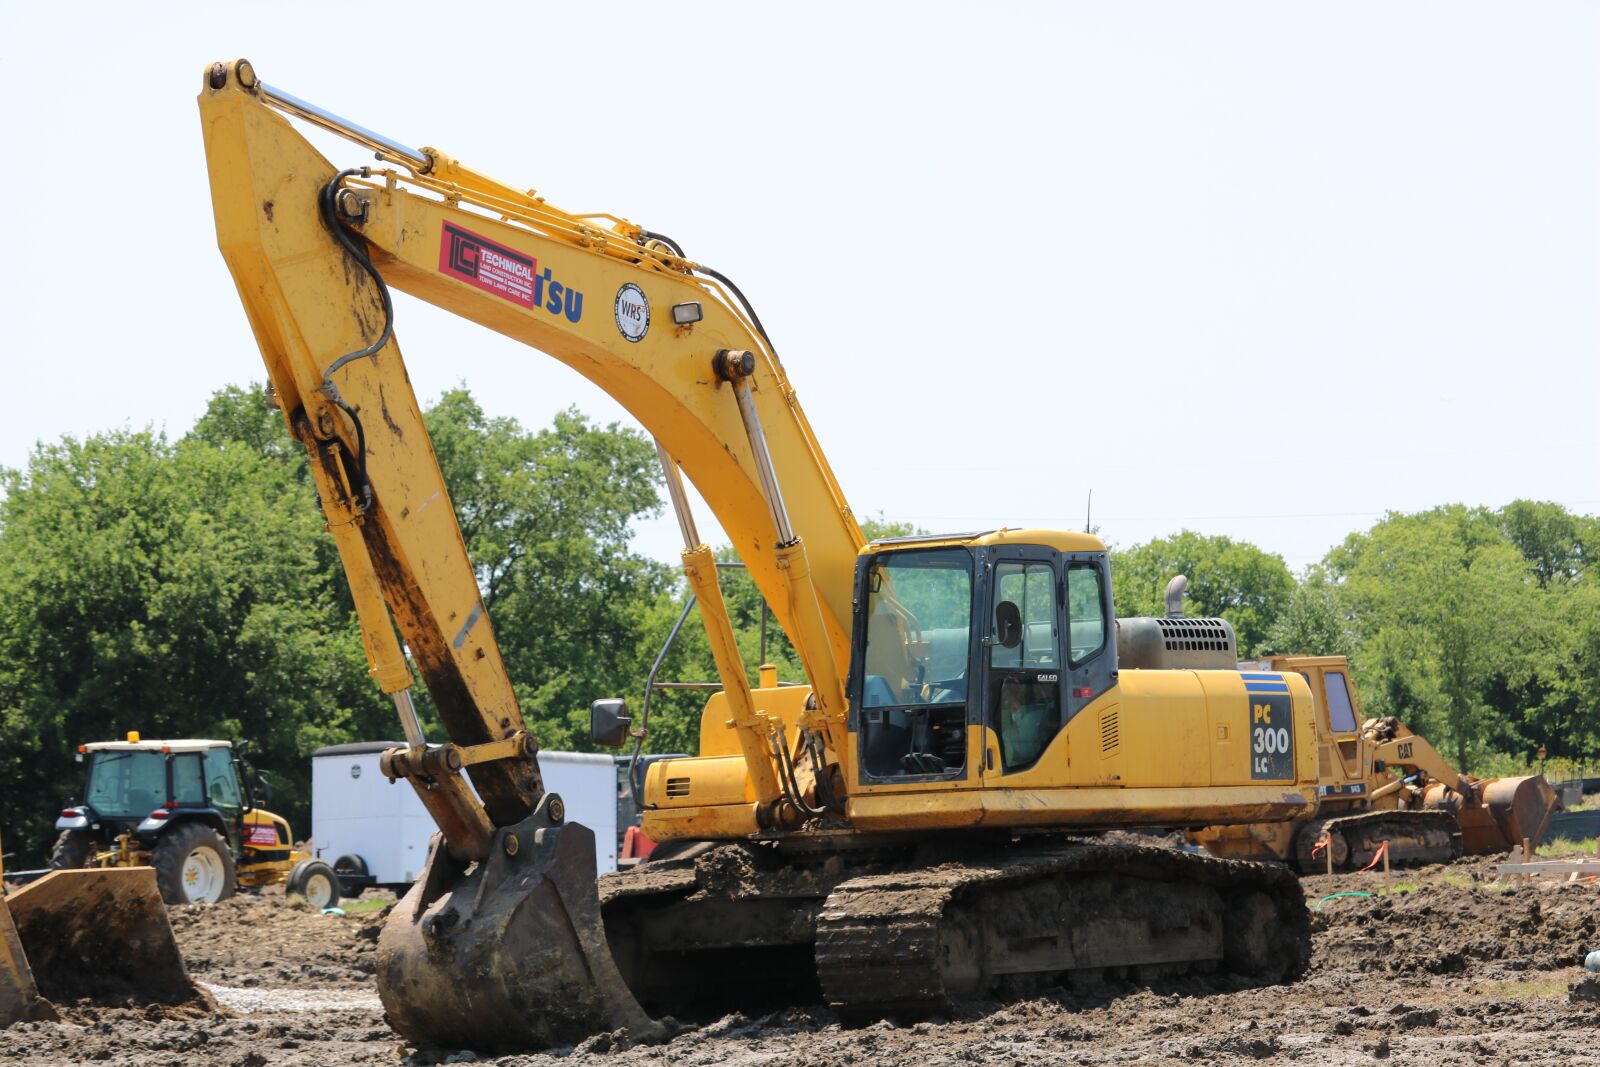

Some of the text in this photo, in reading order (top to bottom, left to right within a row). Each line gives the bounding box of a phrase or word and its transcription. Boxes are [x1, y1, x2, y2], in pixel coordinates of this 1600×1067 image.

[480, 249, 533, 281] TECHNICAL
[493, 282, 507, 292] LAWN
[508, 287, 521, 298] CARE
[621, 299, 641, 322] WRS
[1254, 704, 1271, 724] PC
[1253, 727, 1289, 754] 300
[1397, 742, 1413, 759] CAT
[1255, 757, 1268, 773] LC
